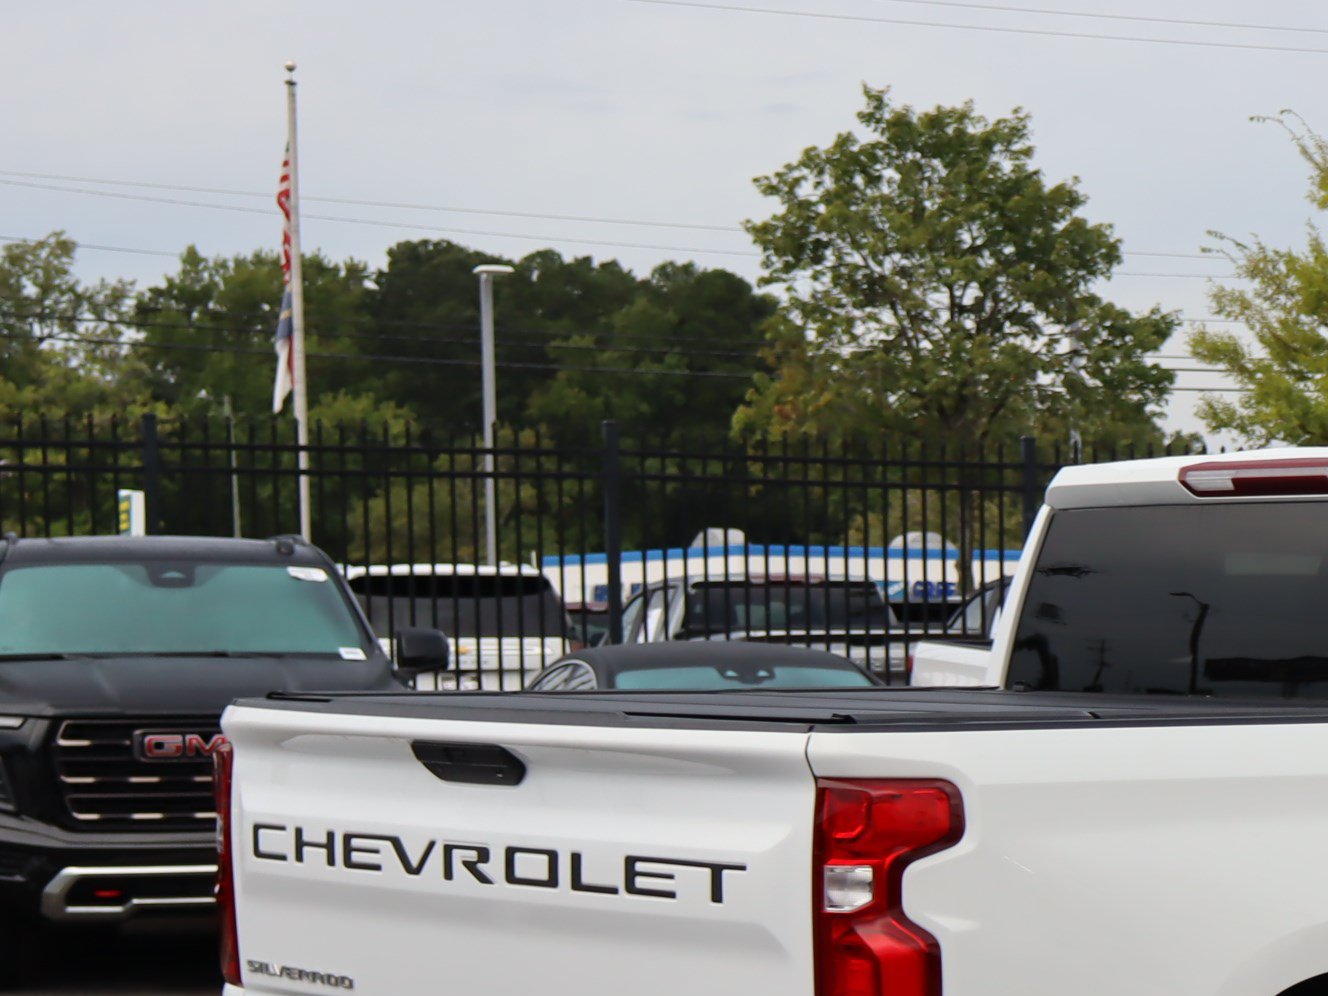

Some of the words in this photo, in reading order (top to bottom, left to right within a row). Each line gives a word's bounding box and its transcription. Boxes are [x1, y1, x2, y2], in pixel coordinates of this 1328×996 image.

[144, 734, 228, 757] GM
[252, 822, 747, 904] CHEVROLET
[247, 959, 354, 990] SILVERADO
